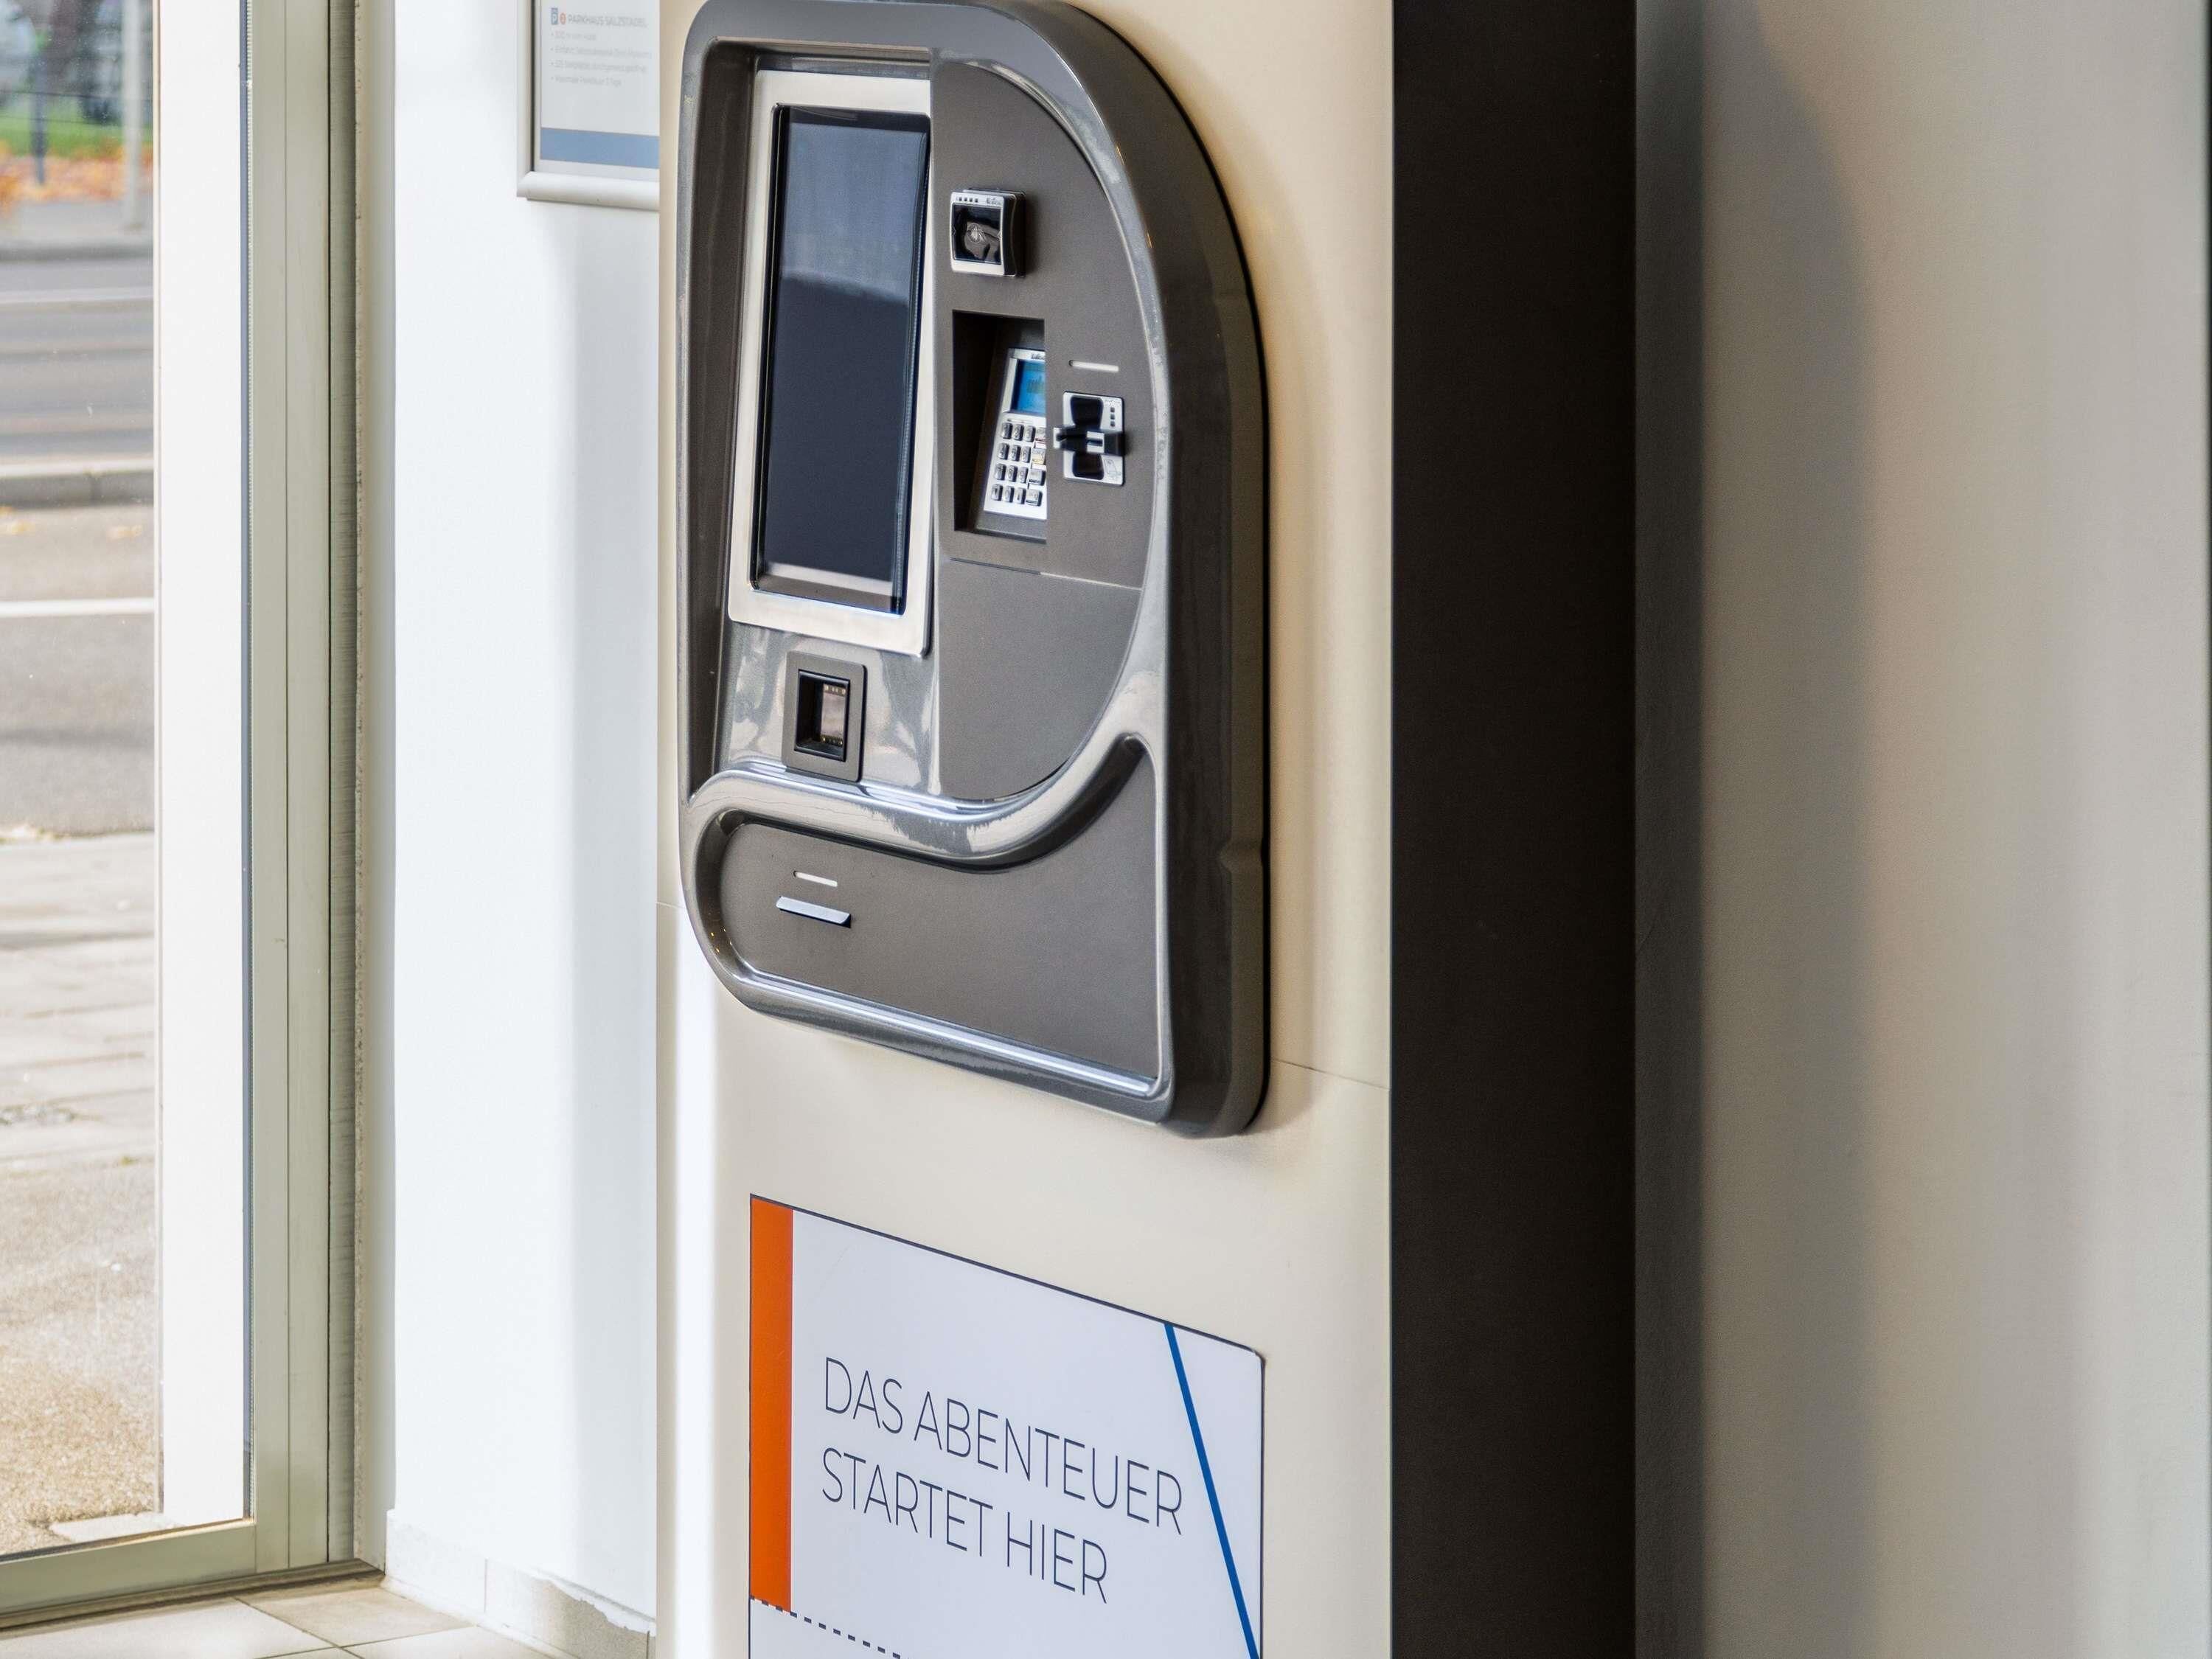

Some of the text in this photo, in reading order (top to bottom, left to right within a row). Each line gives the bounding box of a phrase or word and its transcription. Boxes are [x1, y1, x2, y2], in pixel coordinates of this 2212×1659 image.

[821, 1447, 1108, 1604] STARTET HIER
[825, 1357, 1183, 1536] DAS ABENTEUER
